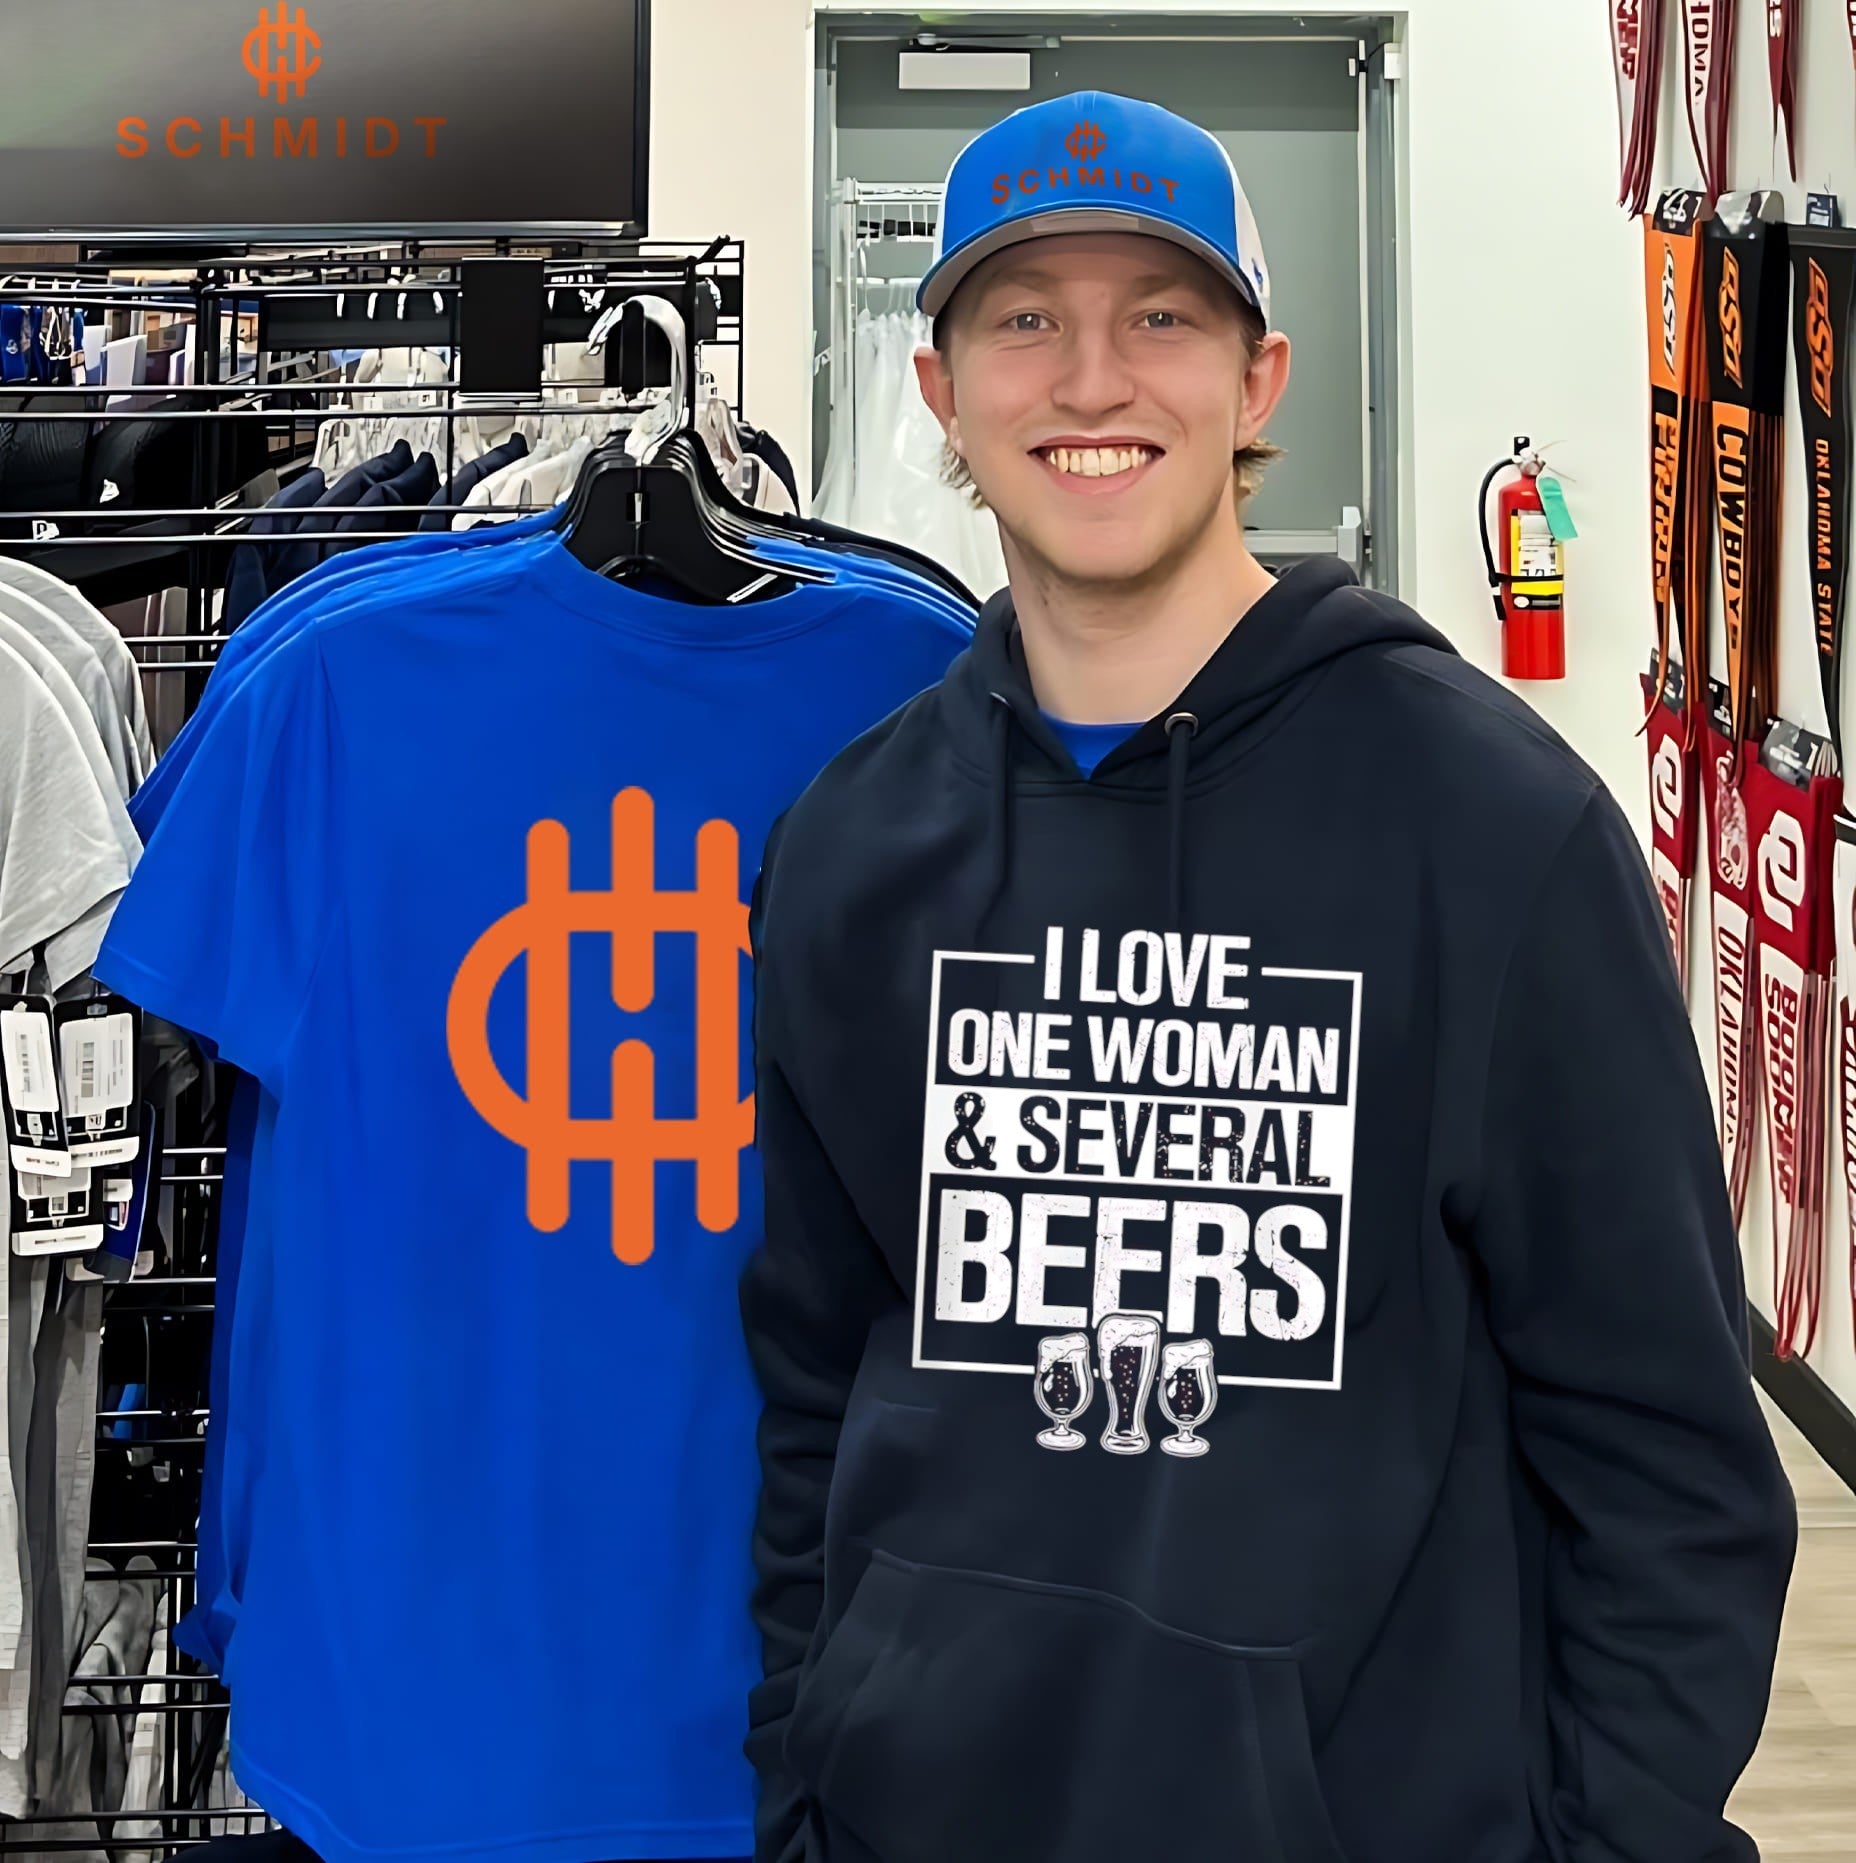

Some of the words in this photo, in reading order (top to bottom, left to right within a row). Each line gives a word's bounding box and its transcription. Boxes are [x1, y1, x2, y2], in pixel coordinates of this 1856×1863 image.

[116, 117, 447, 158] SCHMIDT
[991, 167, 1179, 204] SCHMIDT
[1815, 438, 1832, 570] OKLAHOMA
[1044, 926, 1064, 1000] I
[1080, 928, 1251, 1010] LOVE
[948, 1008, 1072, 1080] ONE
[1087, 1016, 1340, 1094] WOMAN
[945, 1091, 997, 1170] &
[1016, 1095, 1331, 1187] SEVERAL
[934, 1188, 1329, 1340] BEERS
